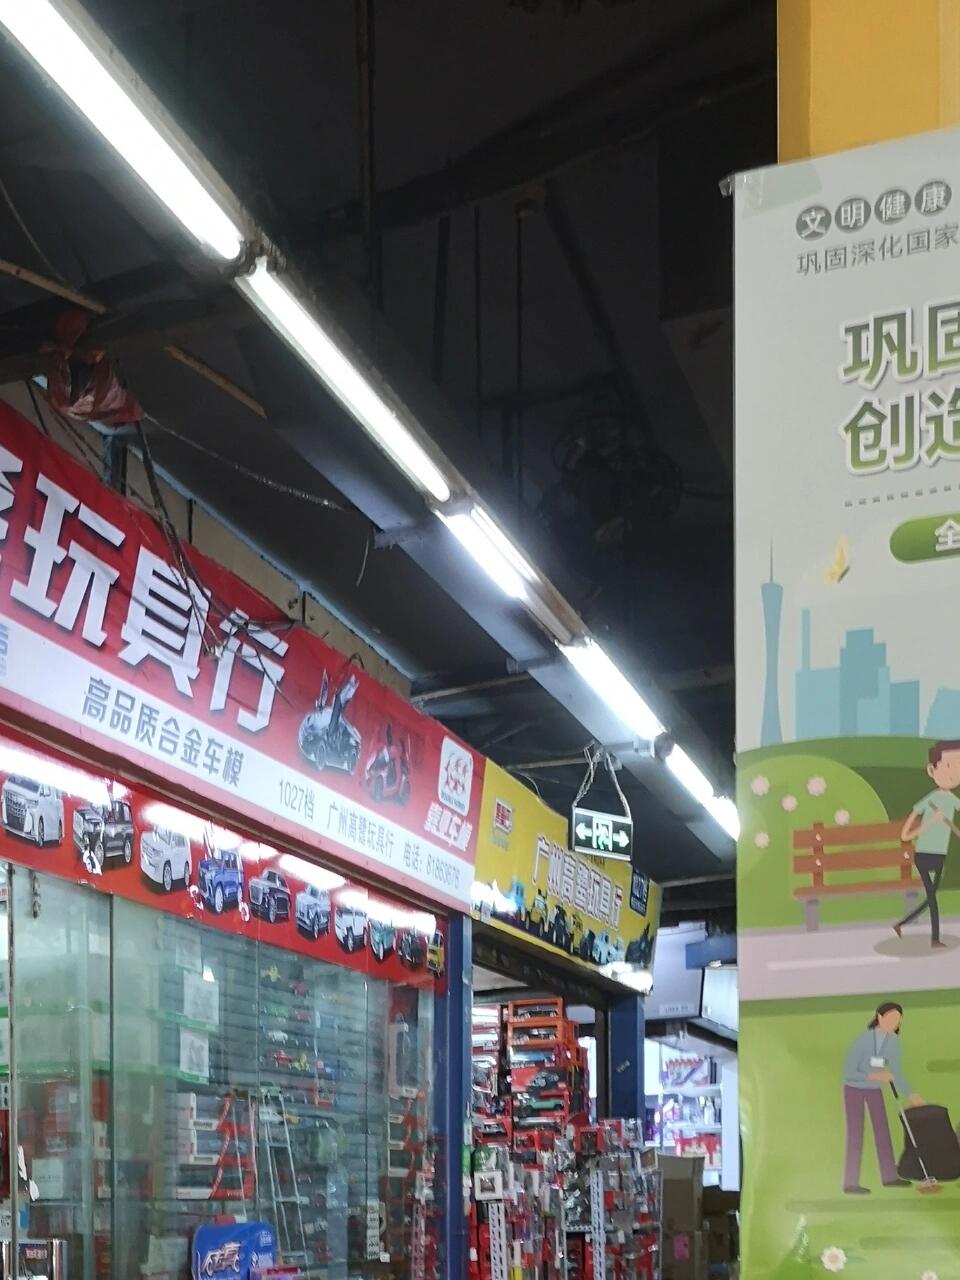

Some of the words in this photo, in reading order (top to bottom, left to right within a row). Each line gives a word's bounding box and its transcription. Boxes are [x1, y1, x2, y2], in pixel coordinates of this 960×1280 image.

[797, 180, 952, 241] 文明健康
[796, 223, 960, 276] 巩固深化国家
[81, 675, 246, 789] 高品质合金车模
